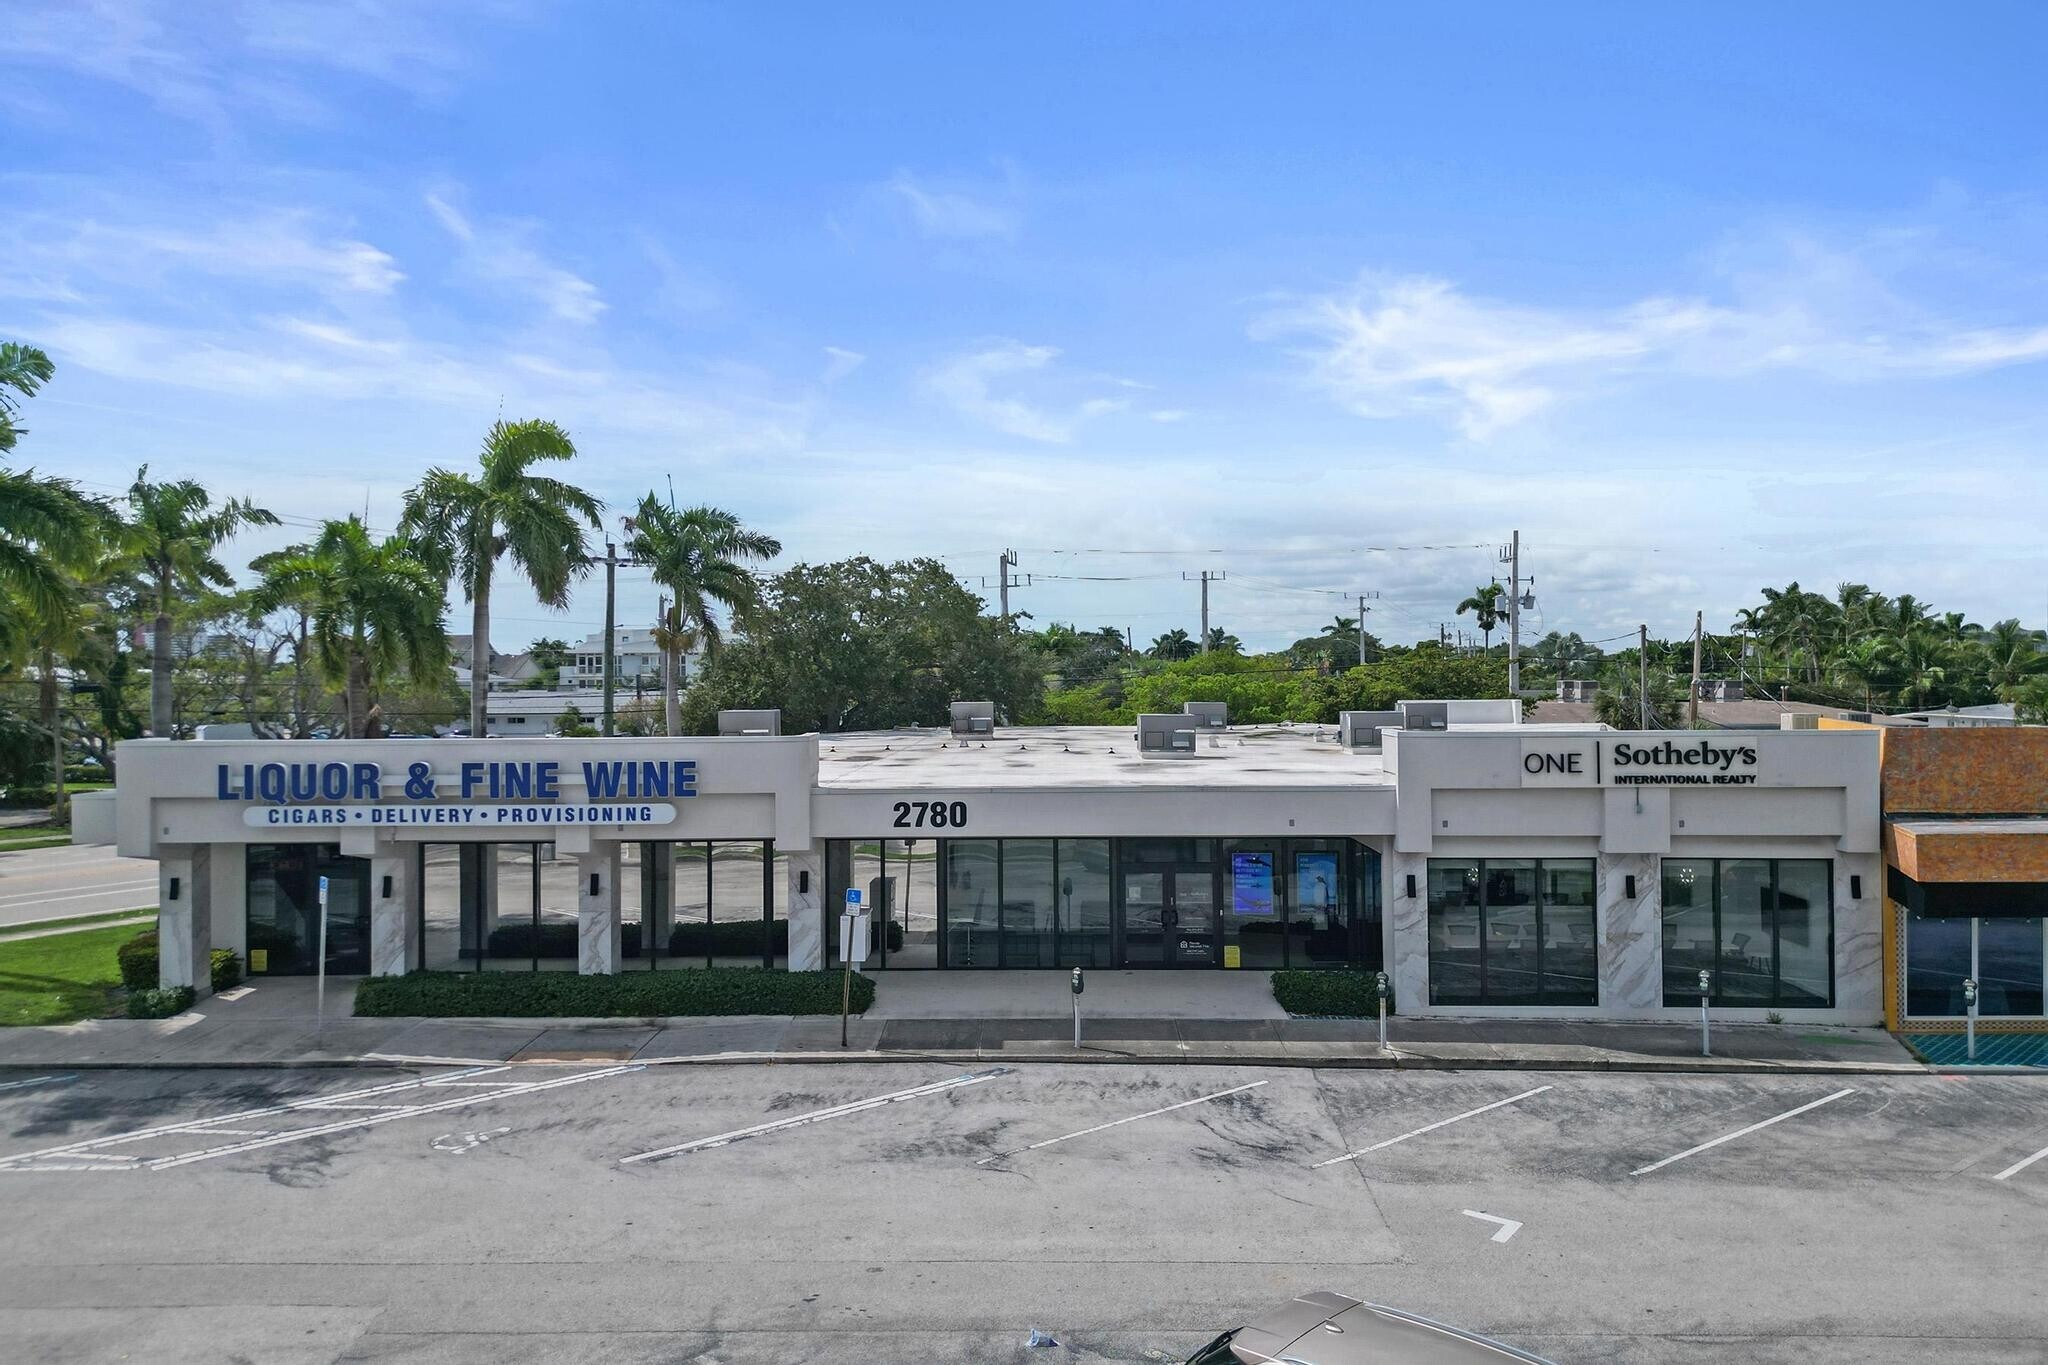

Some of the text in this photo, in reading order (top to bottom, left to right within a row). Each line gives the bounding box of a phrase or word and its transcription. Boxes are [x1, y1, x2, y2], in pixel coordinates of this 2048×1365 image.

[1524, 740, 1758, 774] ONE Sotheby's
[217, 760, 698, 805] LIQUOR & FINE WINE
[1614, 774, 1757, 785] INTERNATIONAL REALTY
[268, 806, 652, 824] CIGARS DELIVERY PROVISIONING
[893, 801, 968, 828] 2780
